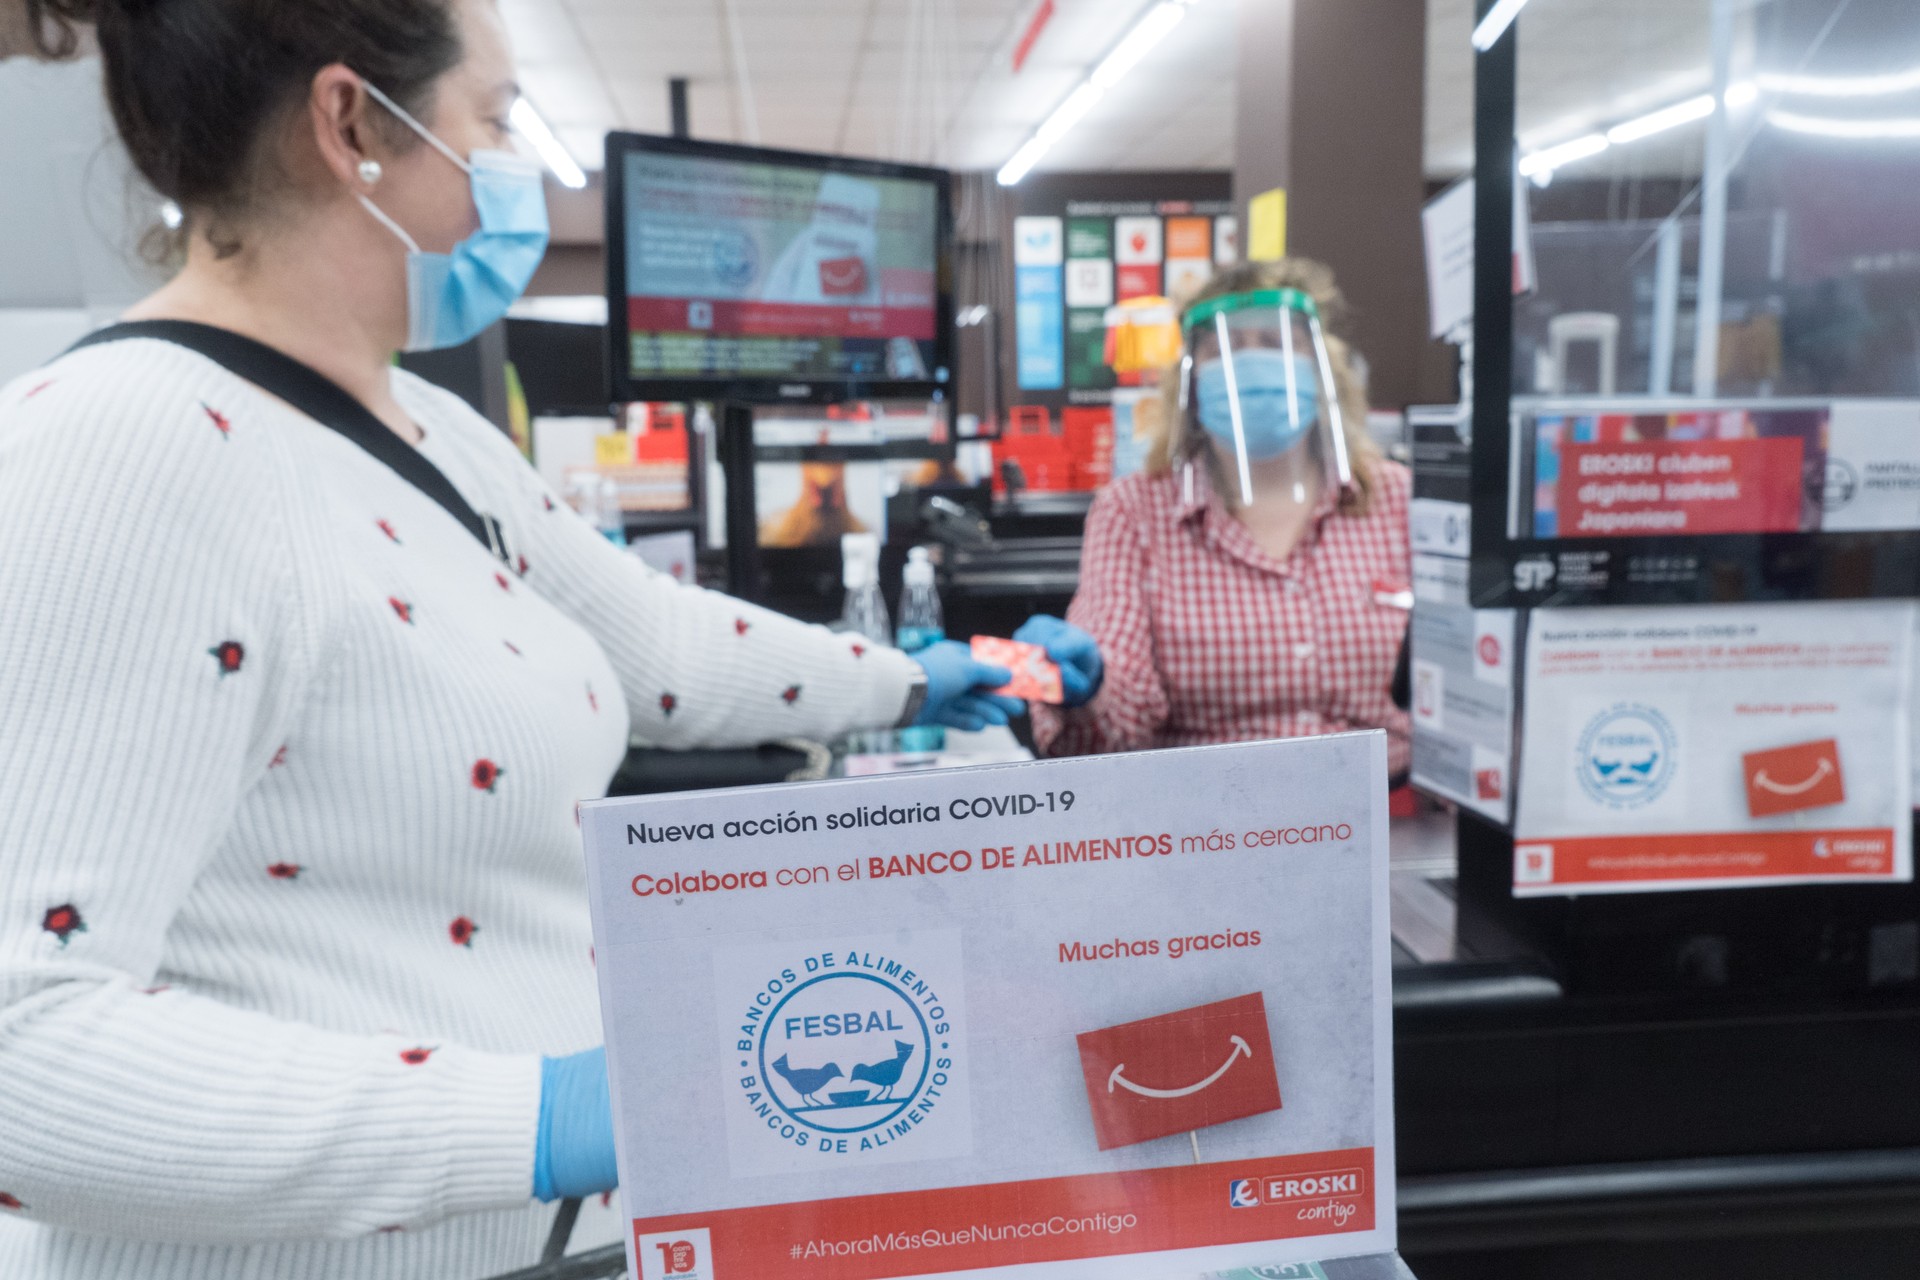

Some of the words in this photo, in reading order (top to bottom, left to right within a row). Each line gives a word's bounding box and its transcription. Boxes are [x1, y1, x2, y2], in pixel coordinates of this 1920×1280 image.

[626, 823, 715, 845] Nueva
[722, 810, 818, 838] acción
[825, 801, 941, 830] solidaria
[948, 790, 1076, 821] COVID-19
[630, 869, 768, 898] Colabora
[775, 865, 830, 887] con
[837, 858, 861, 882] el
[867, 849, 973, 880] BANCO
[981, 846, 1015, 871] DE
[1022, 833, 1173, 867] ALIMENTOS
[1180, 828, 1237, 854] más
[1242, 822, 1353, 848] cercano
[1058, 938, 1160, 963] Muchas
[1167, 928, 1262, 960] gracias
[737, 968, 797, 1052] BANCOS
[804, 952, 835, 973] DE
[845, 951, 950, 1036] ALIMENTOS
[785, 1009, 904, 1040] FESBAL
[740, 1075, 810, 1147] BANCOS
[818, 1138, 848, 1154] DE
[859, 1057, 952, 1152] ALIMENTOS
[1269, 1173, 1357, 1199] EROSKI
[789, 1212, 1138, 1260] #AhoraMásQueNuncaContigo
[1296, 1199, 1357, 1227] contigo
